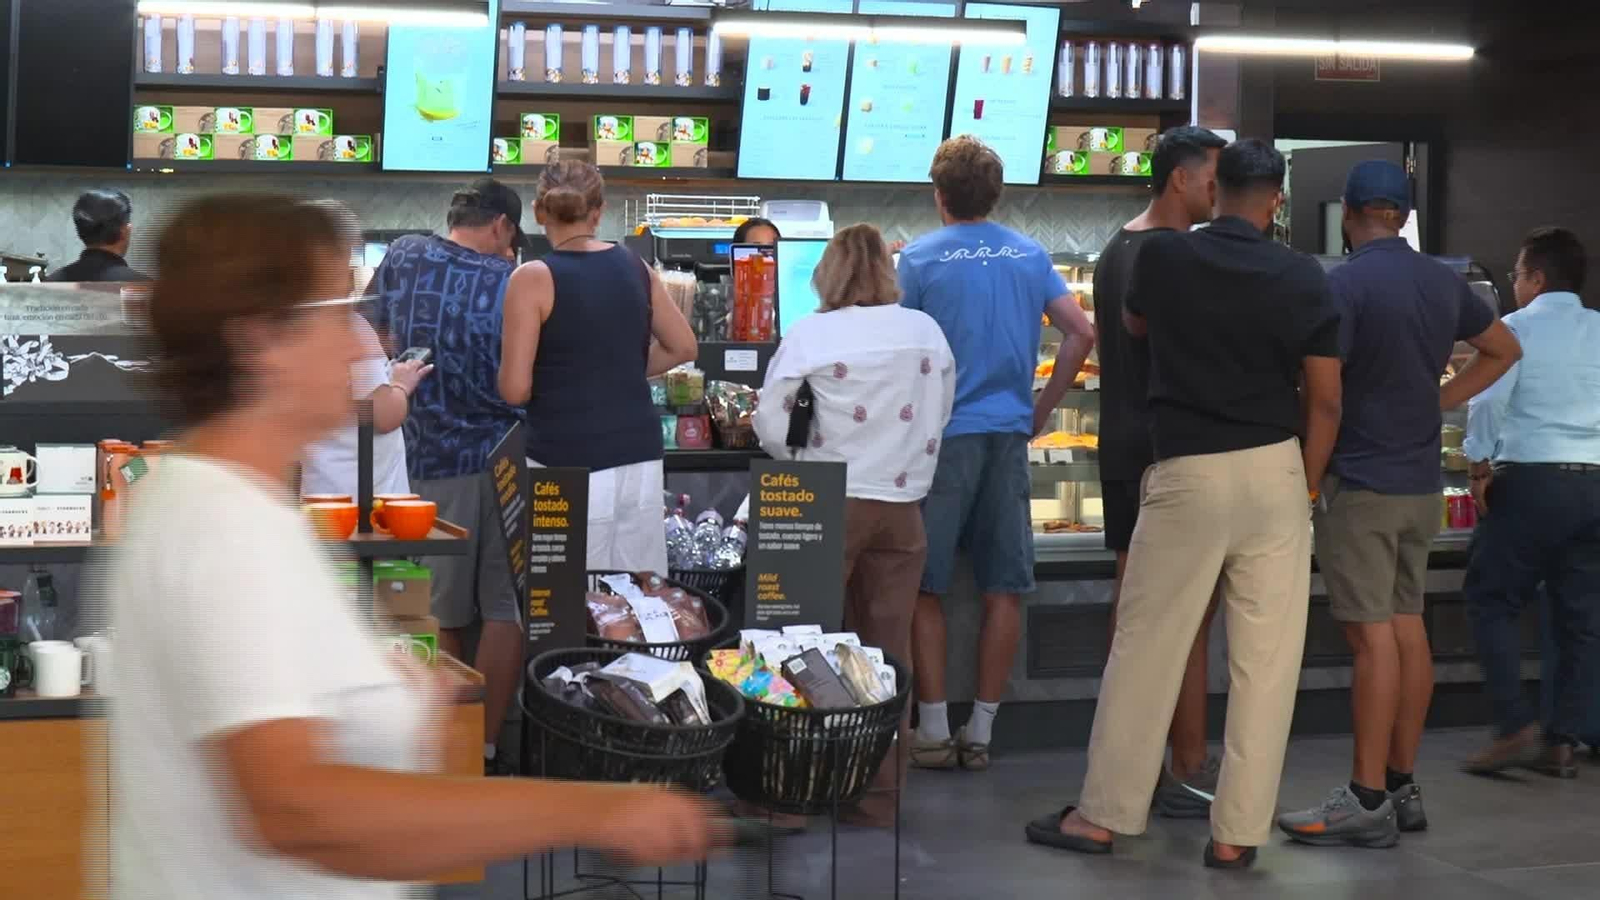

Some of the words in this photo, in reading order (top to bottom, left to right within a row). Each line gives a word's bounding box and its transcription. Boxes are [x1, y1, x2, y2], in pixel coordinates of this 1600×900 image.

[1319, 55, 1336, 71] SIN
[1339, 55, 1376, 72] SALIDA
[760, 473, 799, 487] Cafés
[534, 482, 560, 496] Cafés
[760, 489, 814, 502] tostado
[533, 498, 569, 512] tostado
[759, 506, 803, 518] suave.
[533, 513, 570, 528] intenso.
[758, 573, 778, 582] Mild
[757, 583, 780, 592] roast
